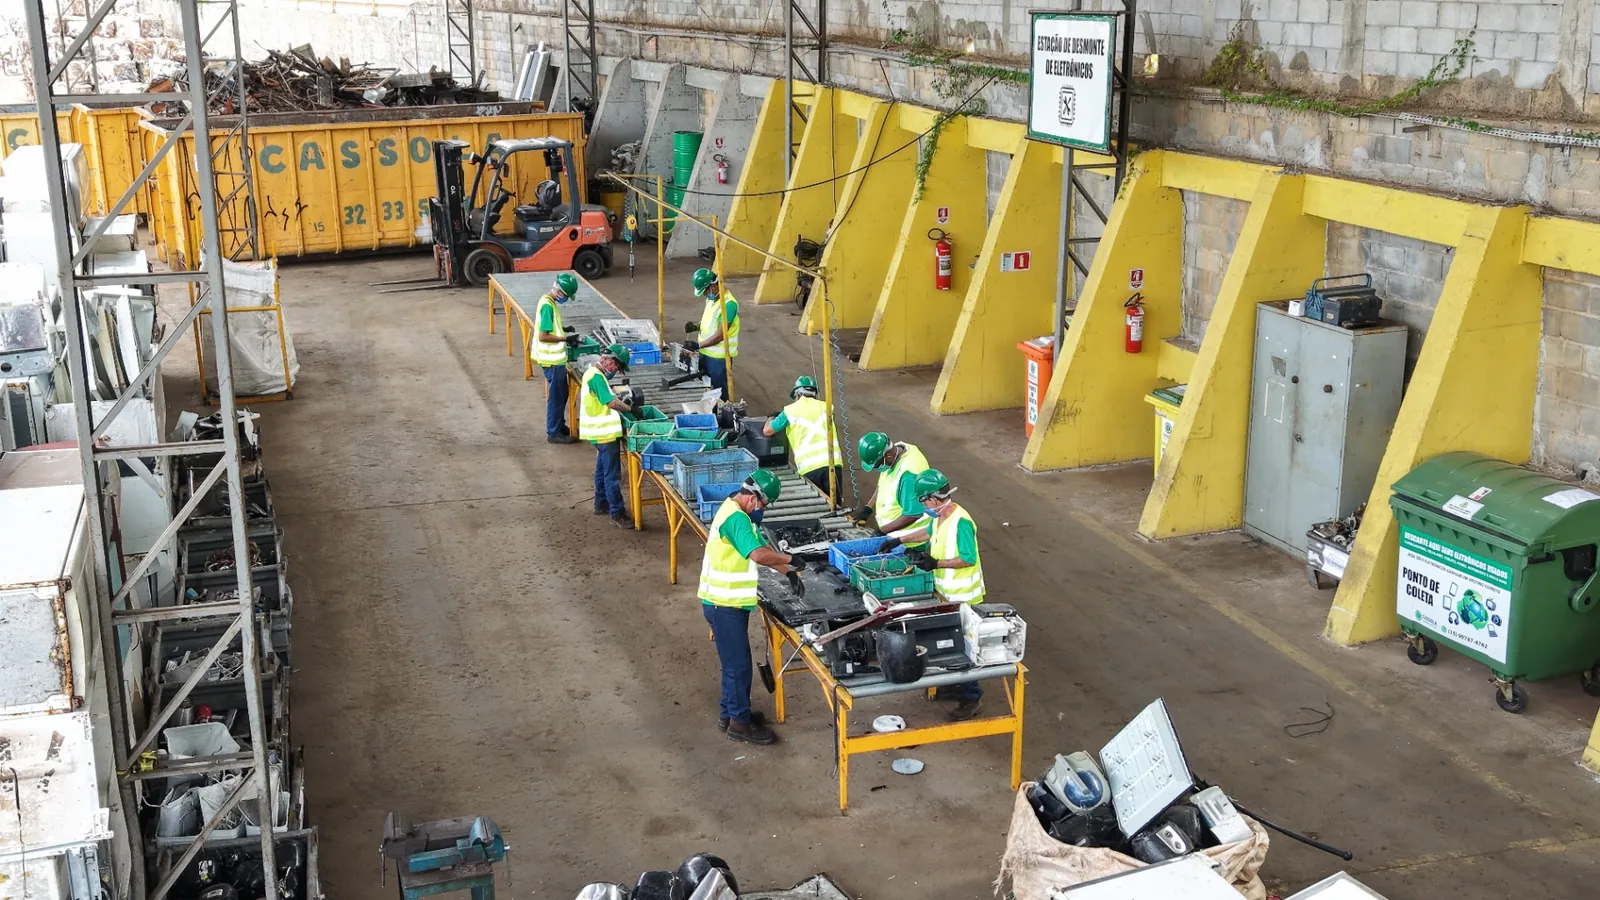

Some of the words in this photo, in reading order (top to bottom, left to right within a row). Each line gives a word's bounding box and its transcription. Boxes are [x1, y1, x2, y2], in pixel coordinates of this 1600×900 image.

[1037, 33, 1062, 55] ESTAÇÃO
[1063, 37, 1071, 53] DE
[1072, 37, 1105, 56] DESMONTE
[1045, 59, 1053, 75] DE
[1054, 57, 1094, 80] ELETRÔNICOS
[260, 132, 506, 174] CASSOA
[344, 204, 367, 225] 32
[382, 200, 405, 220] 33
[1403, 566, 1428, 588] PONTO
[1429, 577, 1440, 594] DE
[1406, 583, 1434, 606] COLETA
